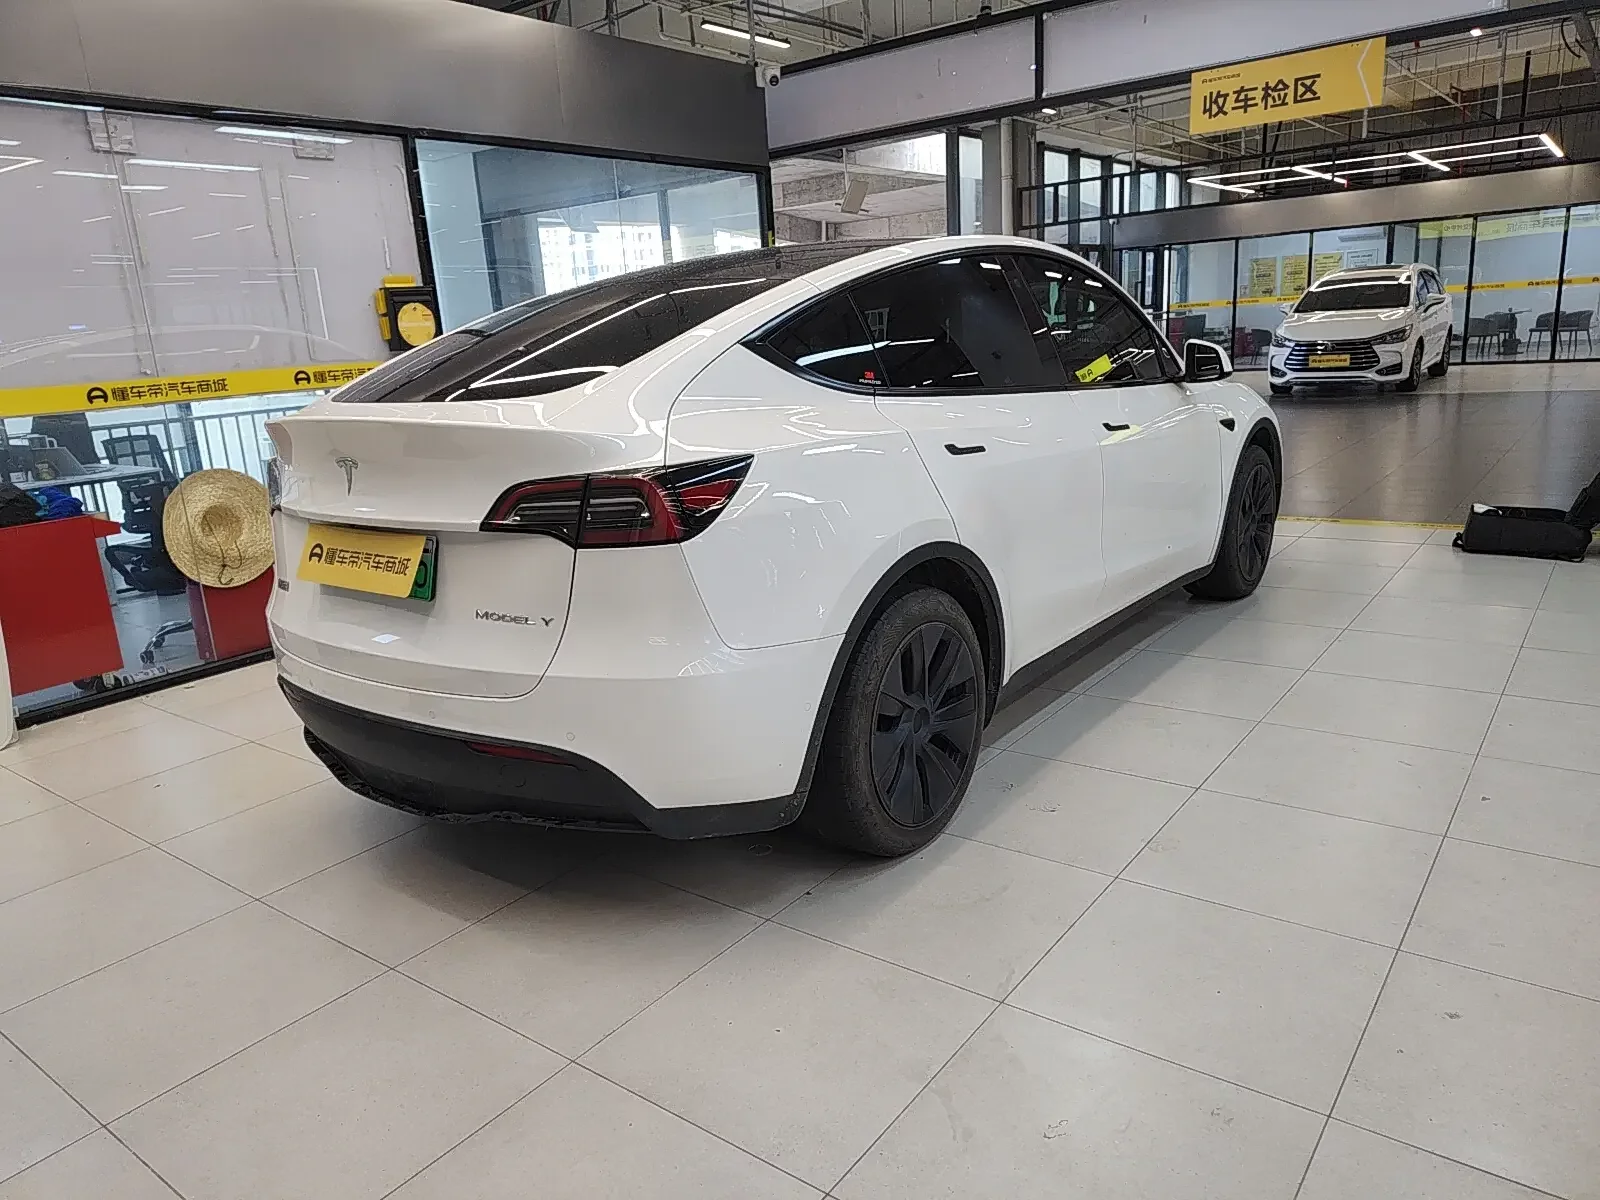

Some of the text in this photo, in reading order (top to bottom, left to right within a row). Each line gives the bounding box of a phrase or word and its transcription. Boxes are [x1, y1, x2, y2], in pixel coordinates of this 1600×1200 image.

[1201, 73, 1322, 120] 收车检区
[110, 377, 230, 402] 懂车帝汽车商城
[323, 546, 412, 576] 懂车帝汽车商城
[475, 608, 555, 628] MODEL Y
